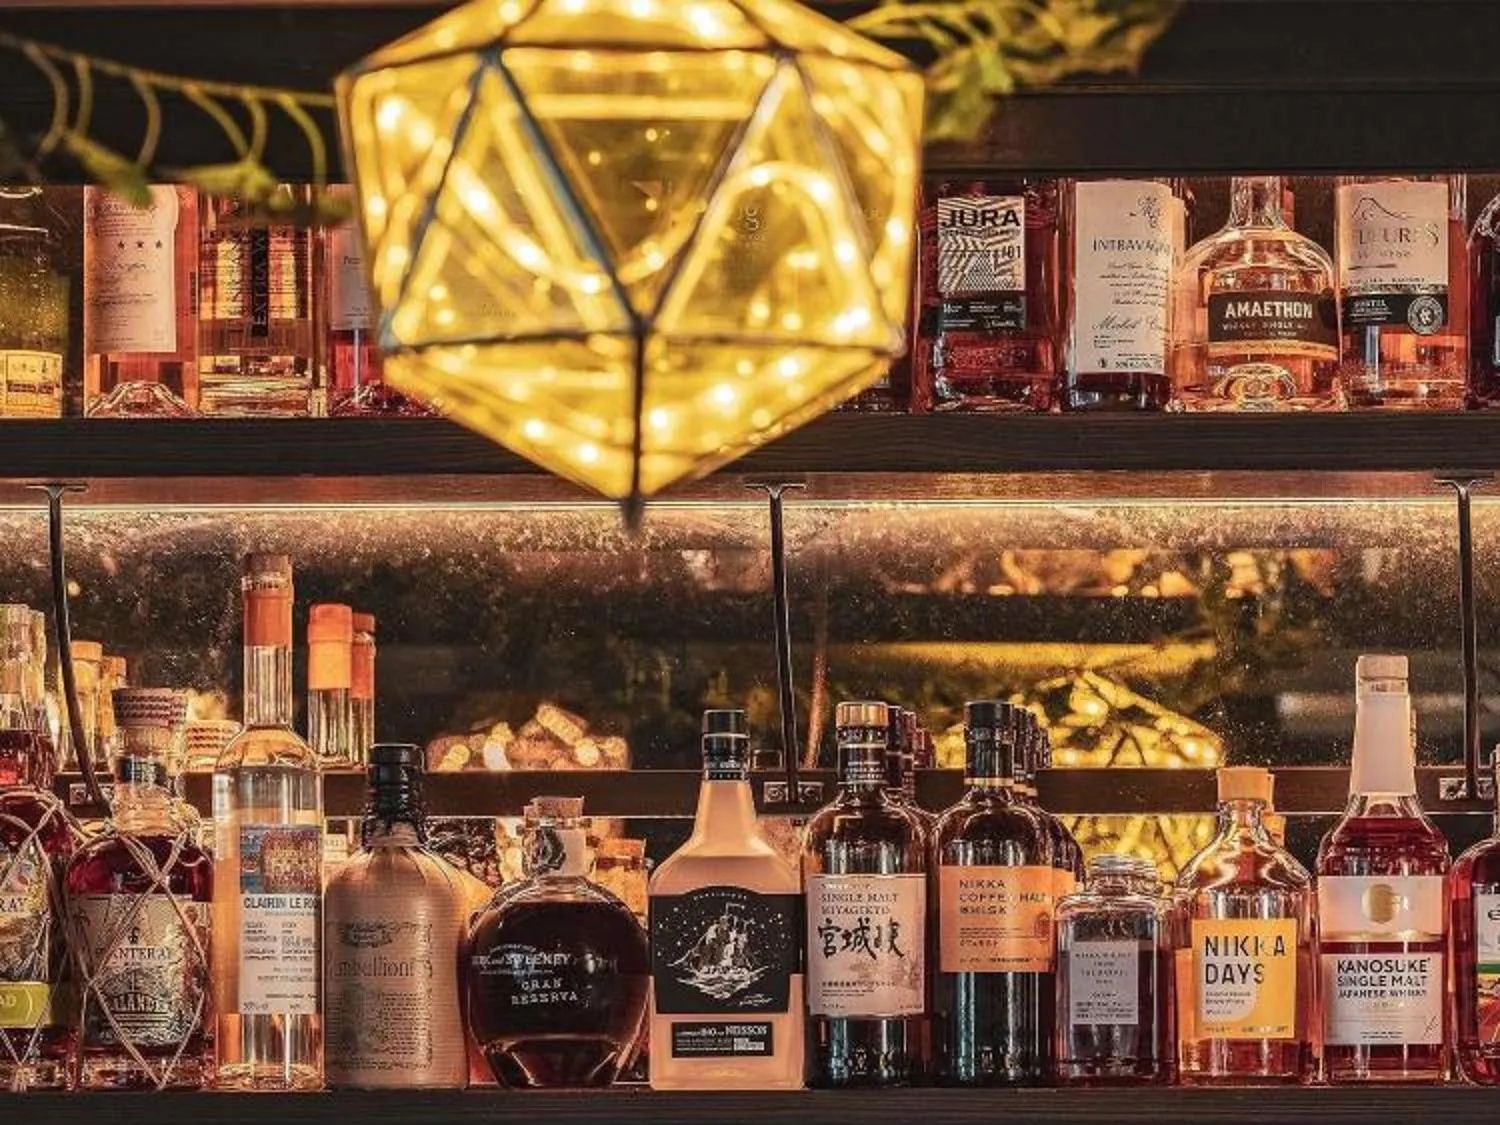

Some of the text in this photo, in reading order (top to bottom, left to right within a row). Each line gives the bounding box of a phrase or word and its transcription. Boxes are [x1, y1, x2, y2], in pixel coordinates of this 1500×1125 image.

[942, 209, 1021, 227] JURA
[1225, 301, 1313, 318] AMAETHON
[959, 879, 1006, 889] NIKKA
[1205, 963, 1265, 985] DAYS
[1337, 958, 1428, 975] KANOSUKE
[1337, 976, 1428, 988] SINGLE MALT
[511, 991, 579, 1005] RESERVA
